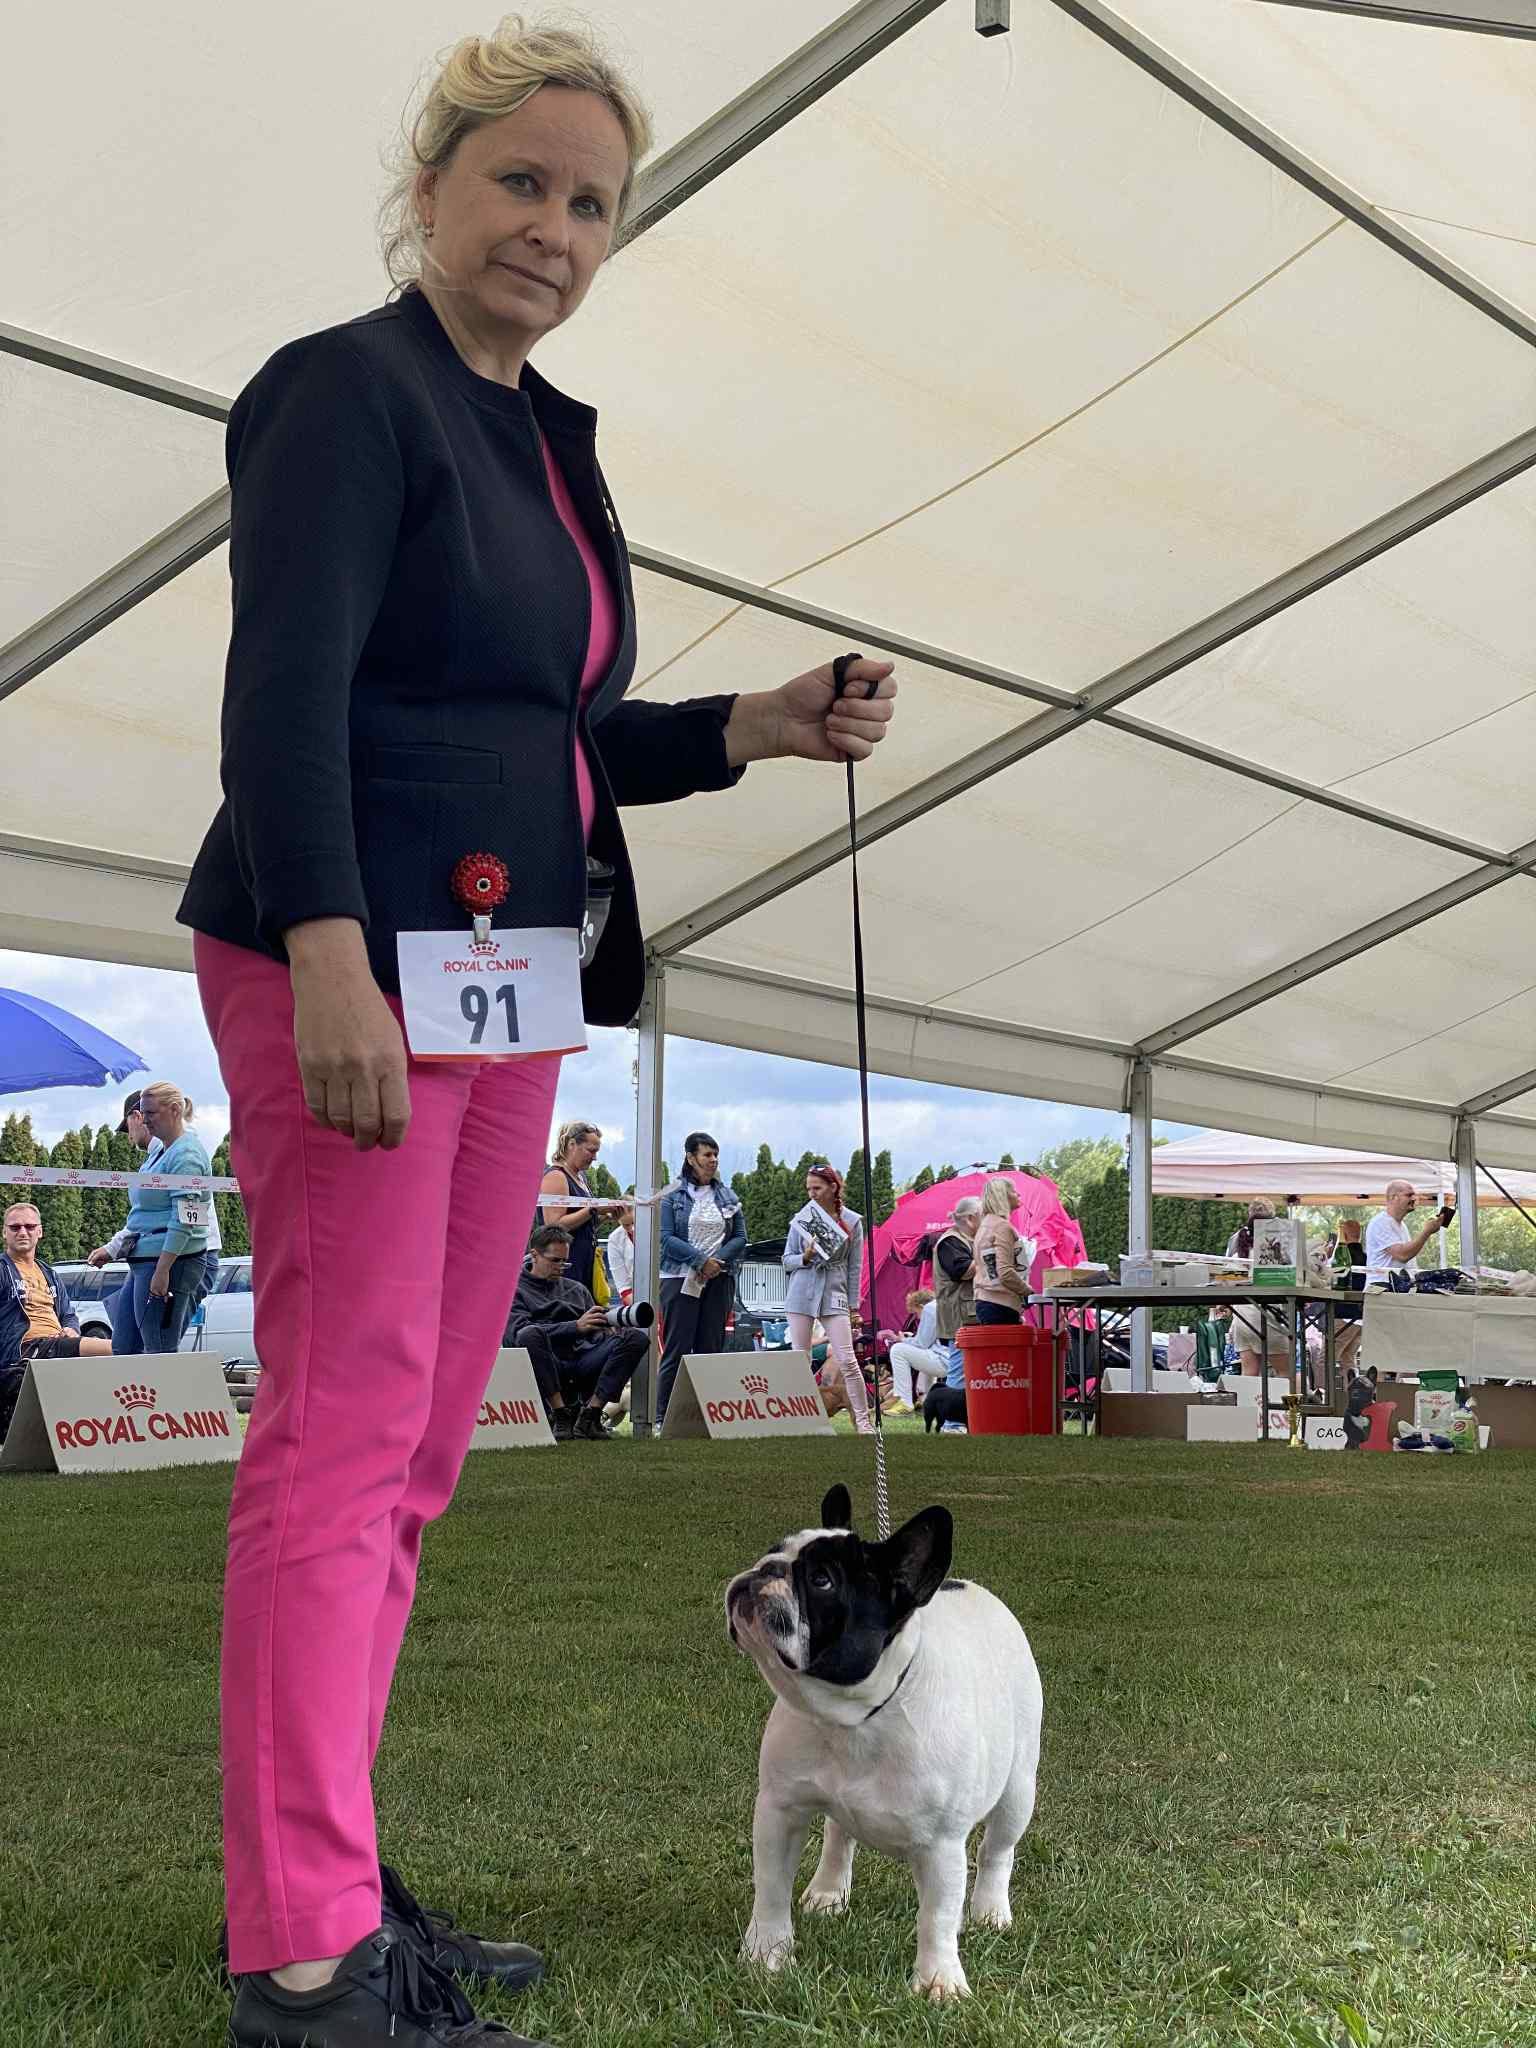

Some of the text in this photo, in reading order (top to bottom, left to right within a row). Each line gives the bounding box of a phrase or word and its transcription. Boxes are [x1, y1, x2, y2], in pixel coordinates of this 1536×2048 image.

[443, 958, 530, 973] ROYAL CANIN
[460, 984, 520, 1044] 91
[186, 1211, 198, 1223] 99
[706, 1396, 820, 1424] ROYAL CANIN
[55, 1410, 231, 1450] ROYAL CANIN
[1316, 1427, 1344, 1438] CAC
